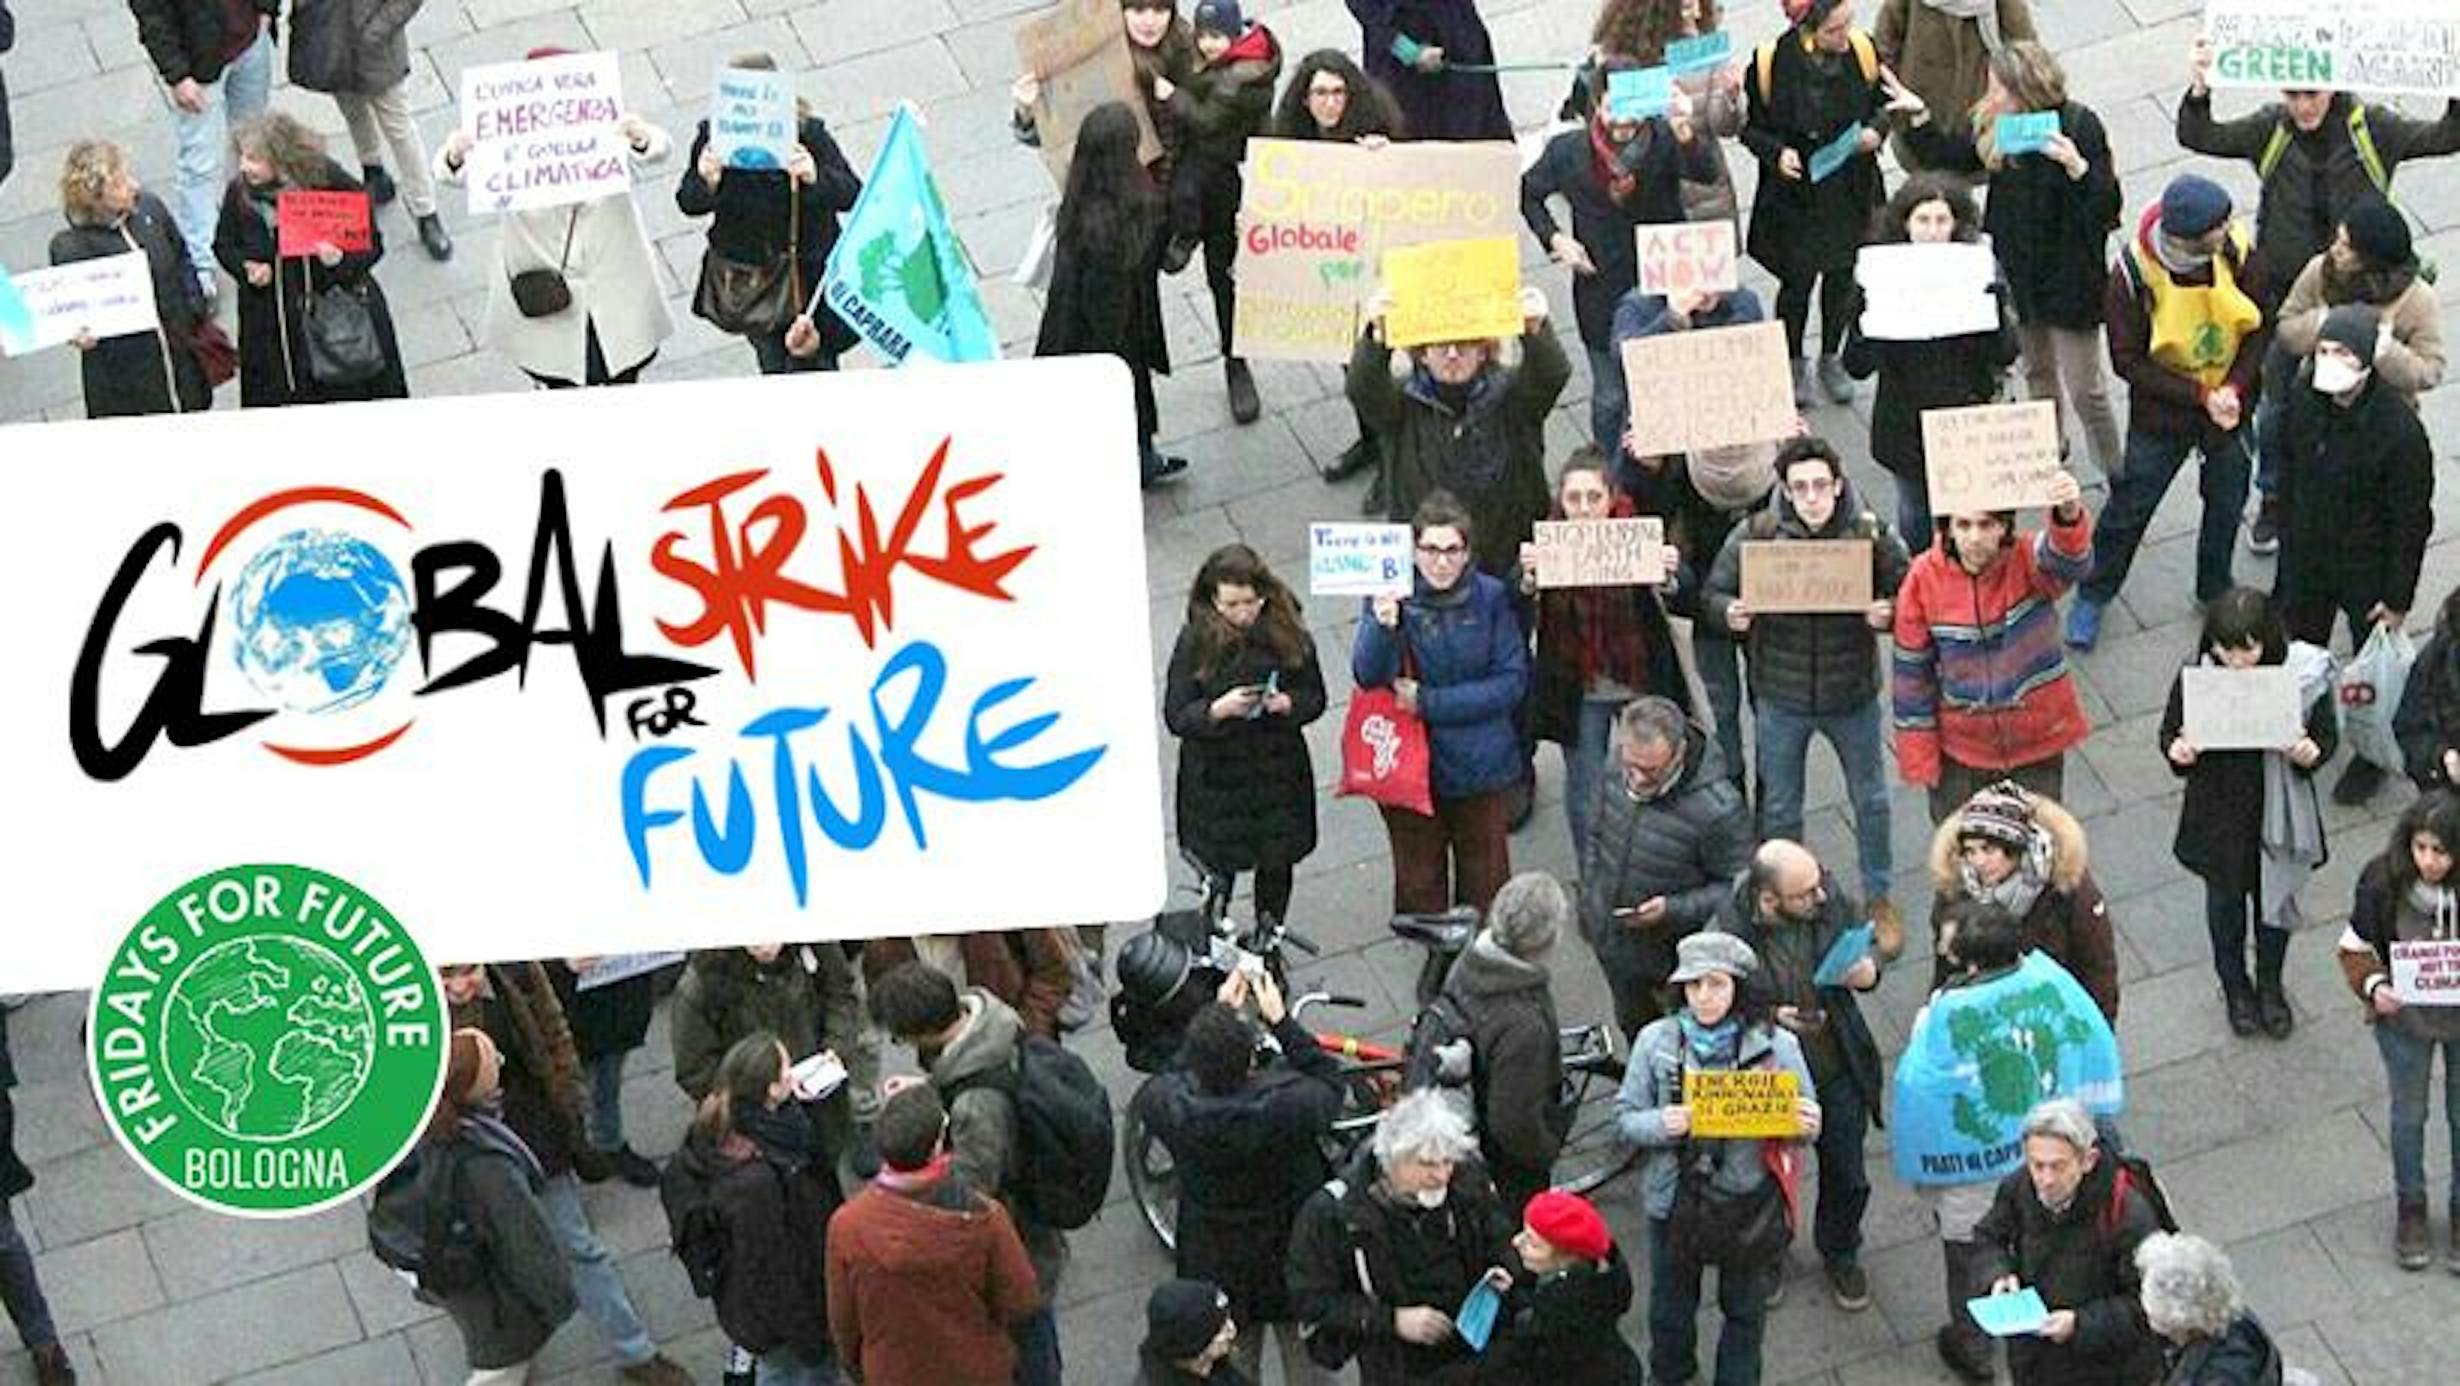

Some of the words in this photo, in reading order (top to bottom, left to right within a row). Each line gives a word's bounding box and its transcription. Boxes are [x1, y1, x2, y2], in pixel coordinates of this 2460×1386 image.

[554, 71, 596, 91] VERA
[2217, 48, 2333, 83] GREEN
[476, 95, 619, 141] EMERGENZA
[485, 156, 625, 194] CLIMATICA
[1247, 223, 1359, 254] Globale
[1646, 225, 1728, 257] ACT
[1319, 259, 1365, 290] per
[1643, 253, 1728, 288] NOW
[842, 293, 912, 360] CAPRARA
